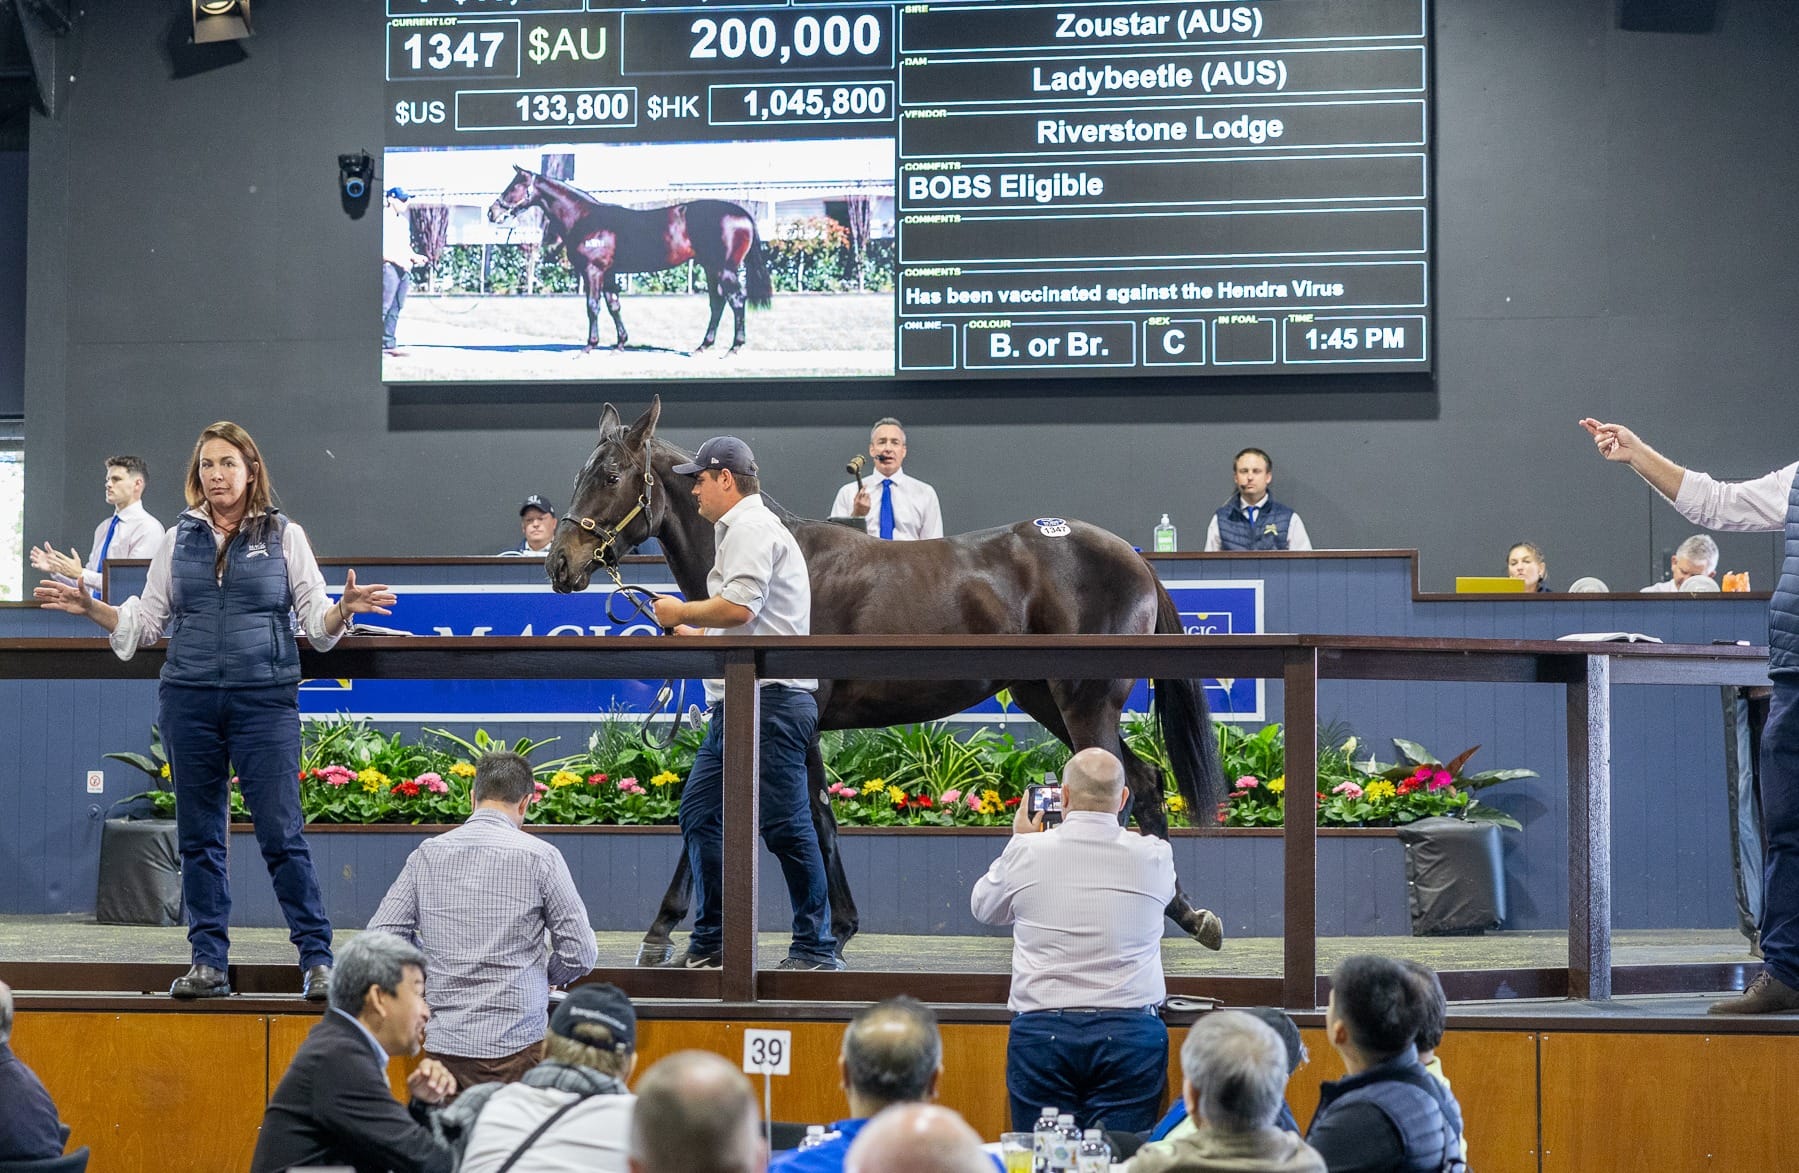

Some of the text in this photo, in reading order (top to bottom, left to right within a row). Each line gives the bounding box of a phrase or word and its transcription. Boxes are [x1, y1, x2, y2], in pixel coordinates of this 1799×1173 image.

[904, 5, 929, 14] SIRE
[392, 17, 458, 27] CURRENT LOT
[1056, 7, 1263, 40] Zoustar (AUS)
[404, 32, 504, 69] 1347
[528, 26, 606, 64] $AU
[690, 15, 880, 64] 200,000
[904, 57, 928, 66] DAM
[1033, 59, 1288, 96] Ladybeetle (AUS)
[395, 101, 446, 126] $US
[516, 93, 629, 125] 133,800
[647, 95, 700, 120] $HK
[744, 87, 886, 121] 1,045,800
[904, 109, 947, 119] VENDOR
[1037, 115, 1284, 144] Riverstone Lodge
[904, 162, 962, 171] COMMENTS
[909, 173, 1104, 203] BOBS Eligible
[904, 215, 962, 224] COMMENTS
[904, 267, 962, 277] COMMENTS
[906, 280, 1344, 304] Has been vaccinated against the Hendra Virus
[904, 321, 942, 330] ONLINE
[968, 320, 1012, 329] COLOUR
[1148, 317, 1170, 325] SEX
[1218, 315, 1259, 324] IN FOAL
[1288, 314, 1314, 323] TIME
[990, 331, 1109, 358] B. or Br.
[1163, 329, 1185, 354] C
[1305, 327, 1404, 350] 1:45 PM
[752, 1038, 782, 1066] 39
